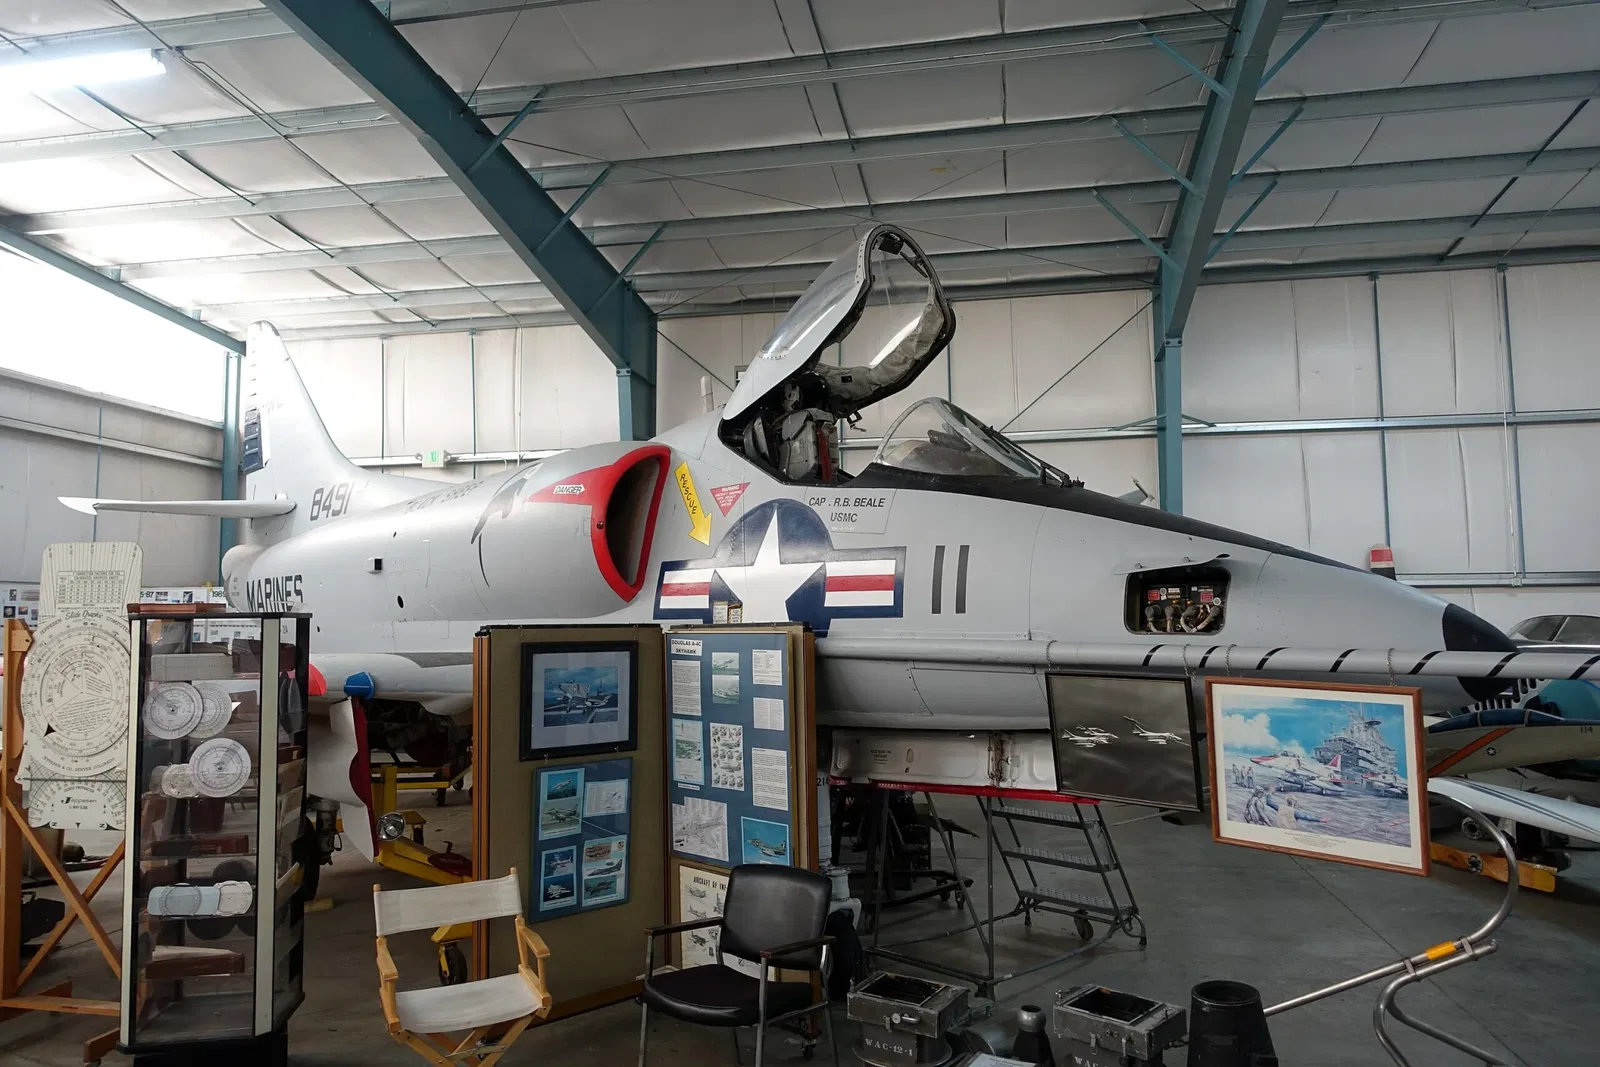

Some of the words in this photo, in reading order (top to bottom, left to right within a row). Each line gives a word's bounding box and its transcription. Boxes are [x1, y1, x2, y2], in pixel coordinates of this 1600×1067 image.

[555, 485, 582, 494] DANGER
[680, 474, 697, 514] RESCUE
[309, 482, 355, 521] 8491
[809, 497, 826, 507] CAP
[834, 497, 851, 507] R.B.
[854, 497, 886, 508] BEALE
[830, 512, 858, 523] USMC
[246, 574, 304, 612] MARINES
[65, 611, 81, 620] Slide
[106, 616, 130, 633] COMPUTE
